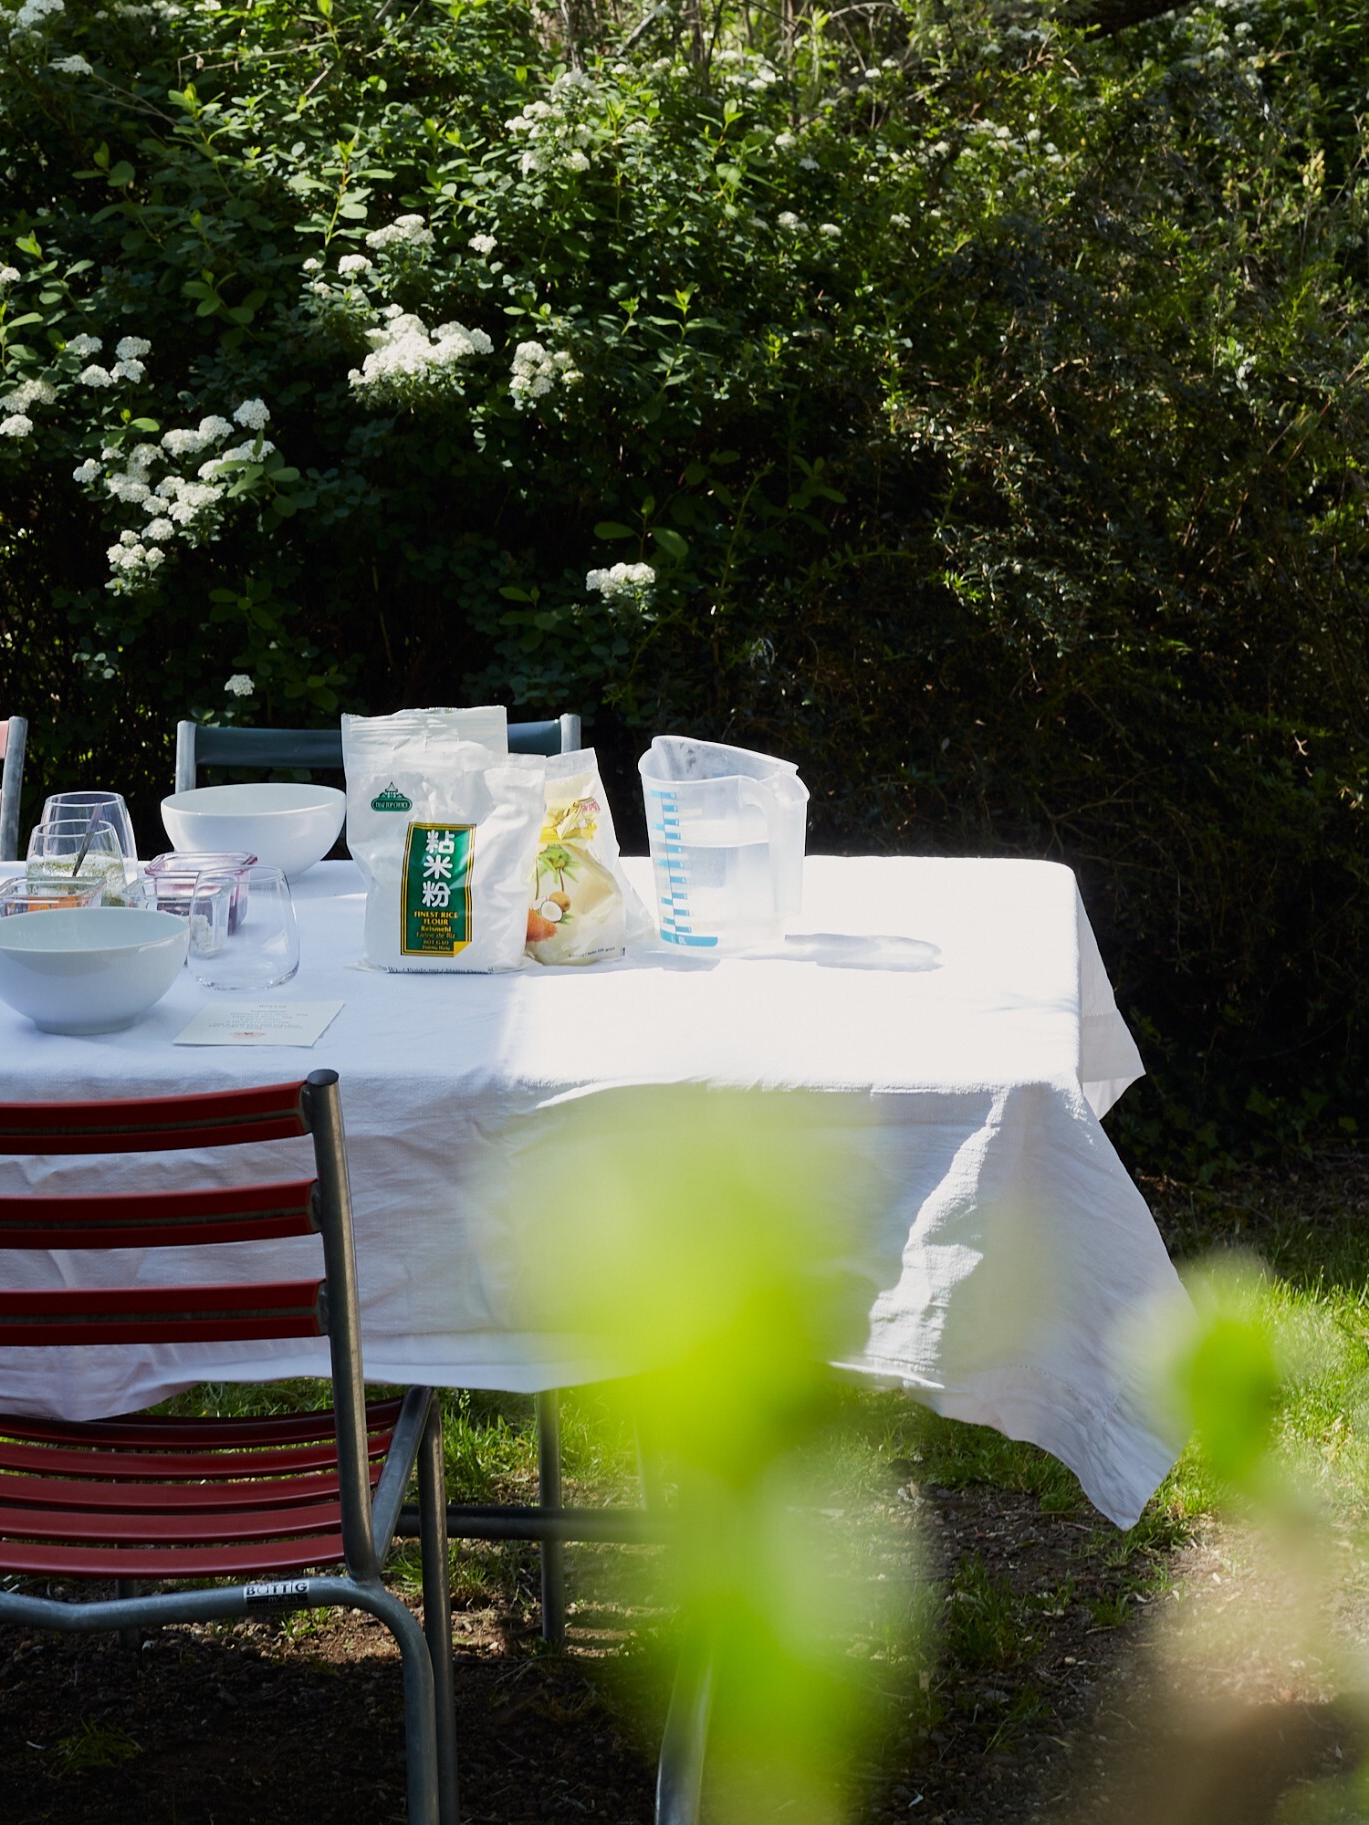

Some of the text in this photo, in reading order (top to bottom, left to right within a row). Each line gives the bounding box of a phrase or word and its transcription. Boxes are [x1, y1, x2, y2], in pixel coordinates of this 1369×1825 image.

[422, 829, 455, 907] 粘米粉
[440, 911, 459, 919] RICE
